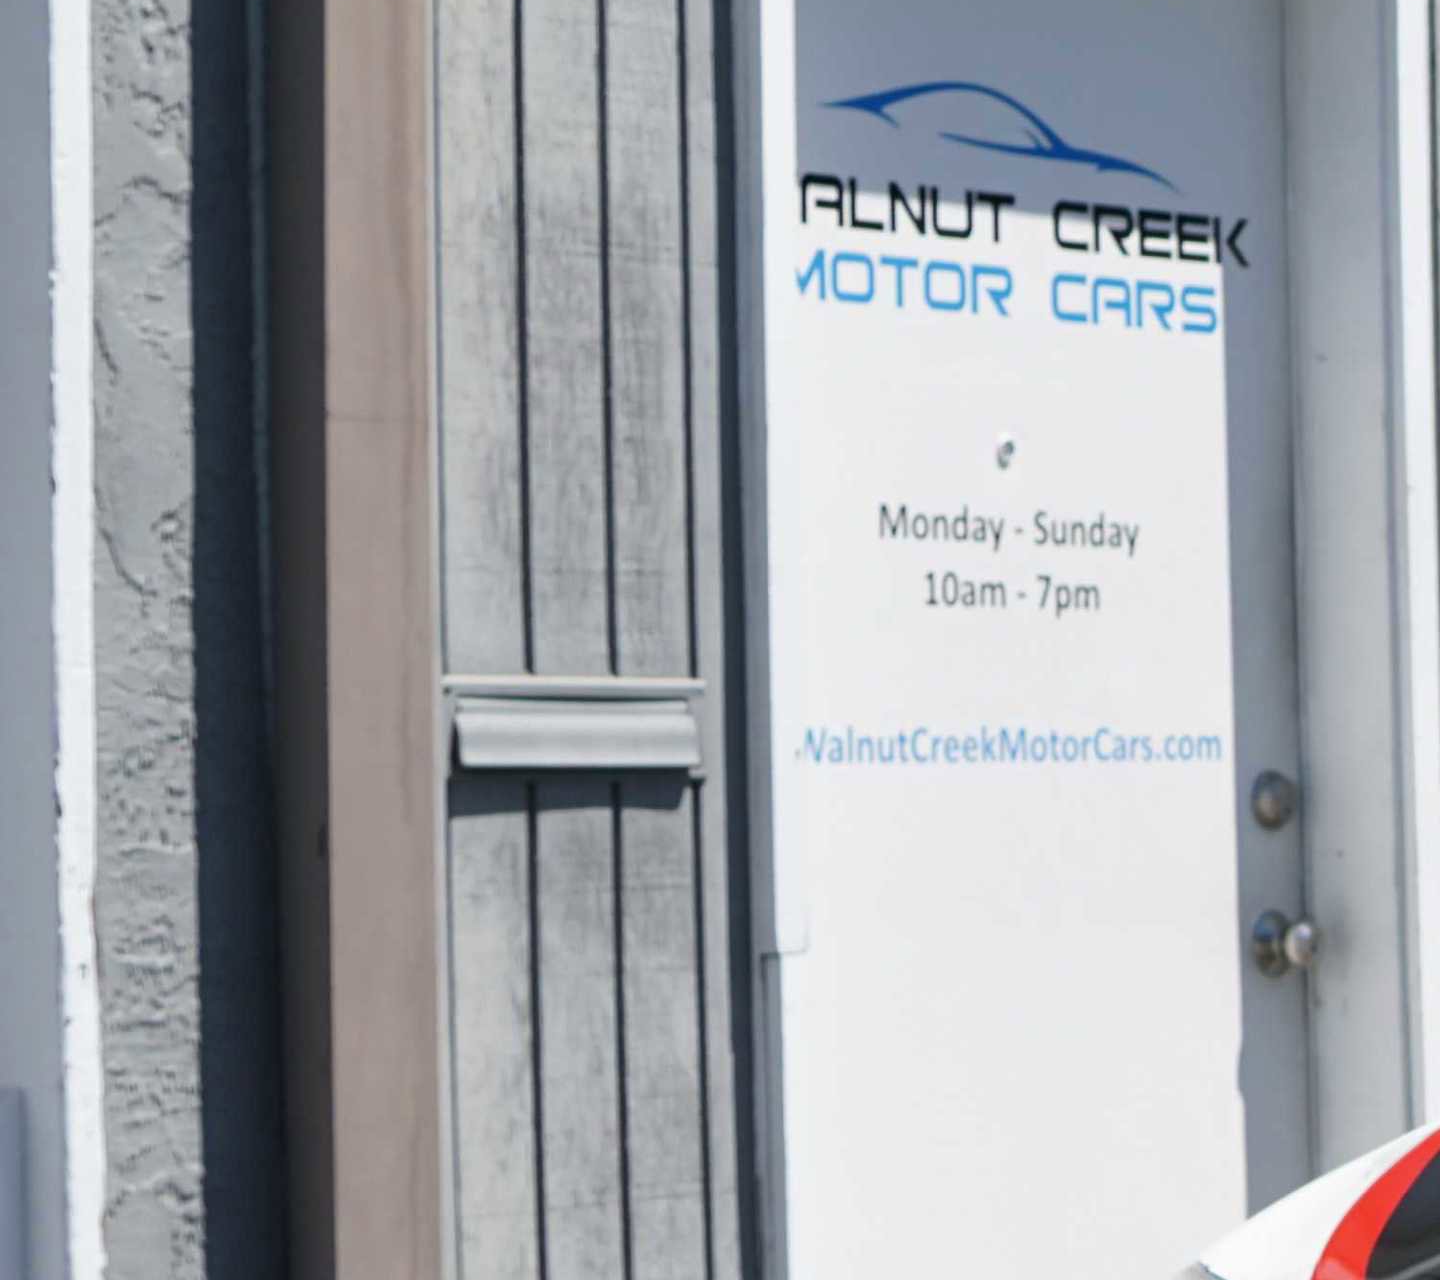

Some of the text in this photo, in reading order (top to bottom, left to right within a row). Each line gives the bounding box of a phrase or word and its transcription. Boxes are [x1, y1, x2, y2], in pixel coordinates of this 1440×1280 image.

[799, 173, 1250, 268] ALNUT CREEK
[1051, 274, 1218, 335] CARS
[878, 502, 1004, 553] Monday
[1033, 510, 1140, 557] Sunday
[924, 571, 1007, 609] 10am
[1036, 575, 1101, 618] 7pm
